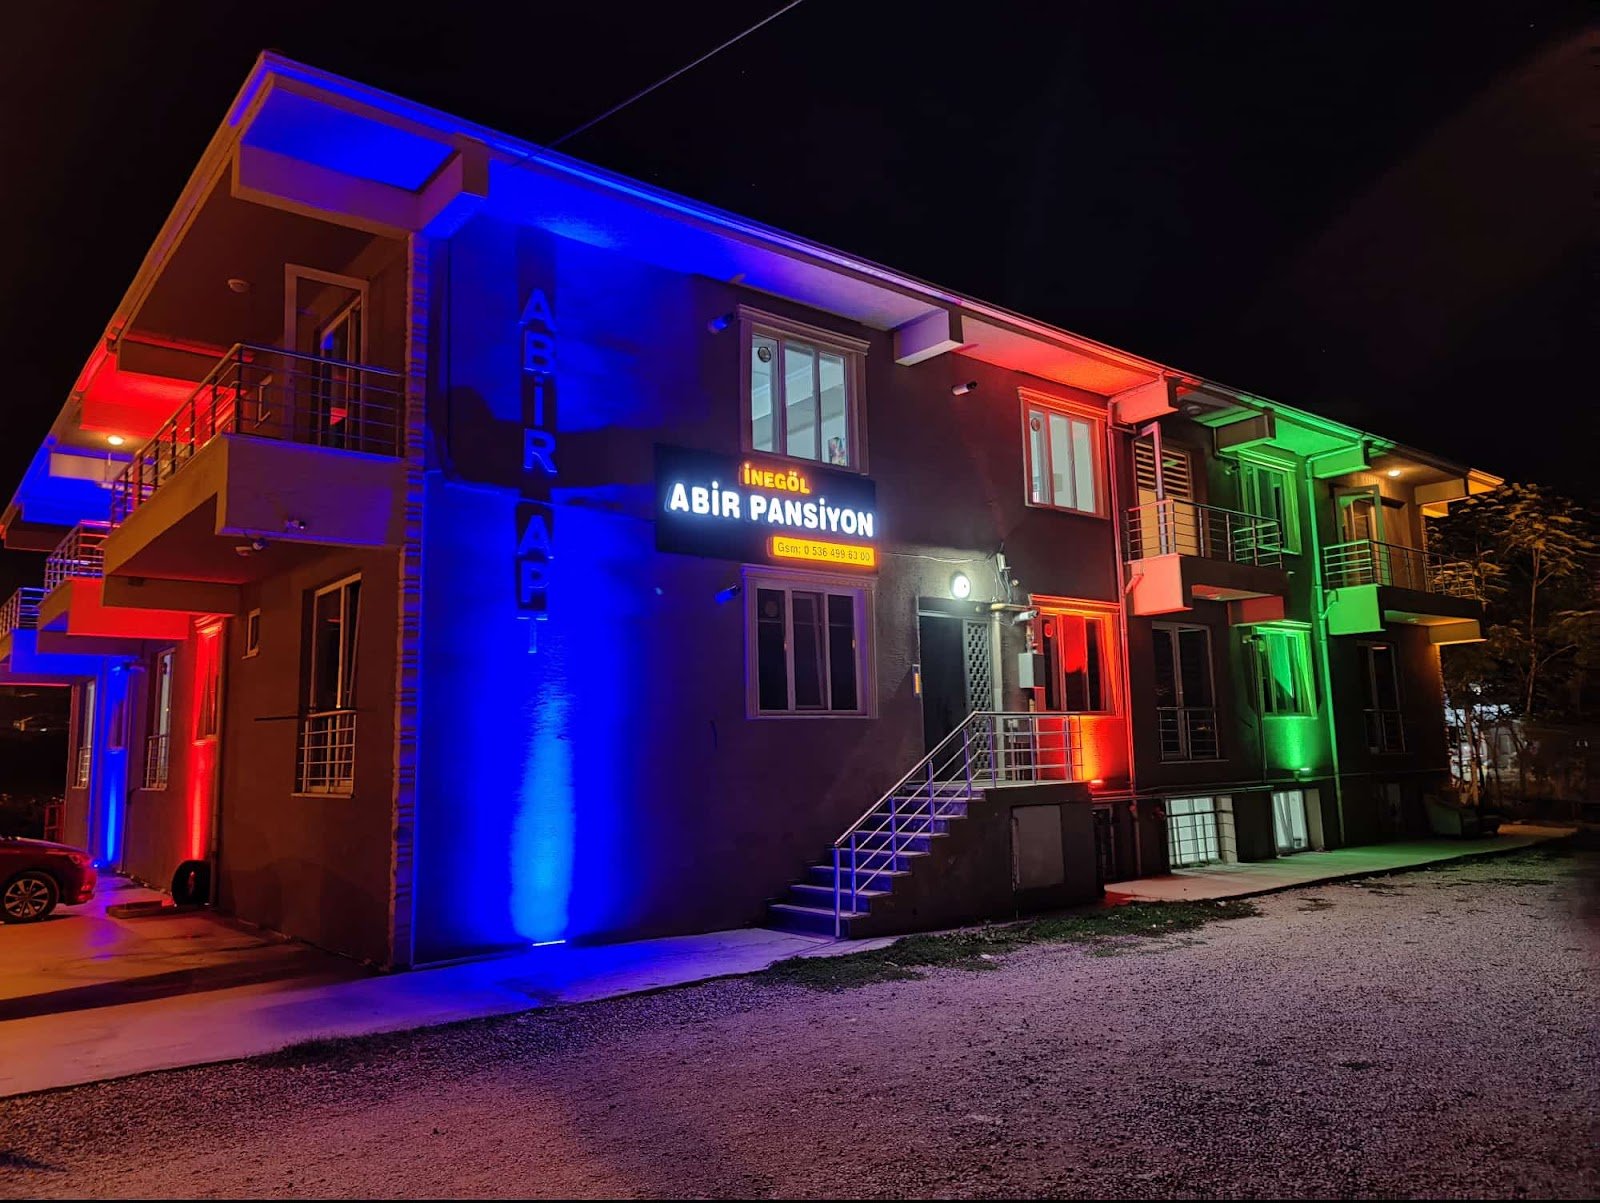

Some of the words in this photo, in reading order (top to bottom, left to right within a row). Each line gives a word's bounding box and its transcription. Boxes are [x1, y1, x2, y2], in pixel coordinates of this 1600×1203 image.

[743, 462, 811, 494] İNEGÖL
[669, 481, 741, 519] ABİR
[750, 498, 874, 538] PANSİYON
[804, 545, 810, 555] 0
[812, 546, 828, 557] 536
